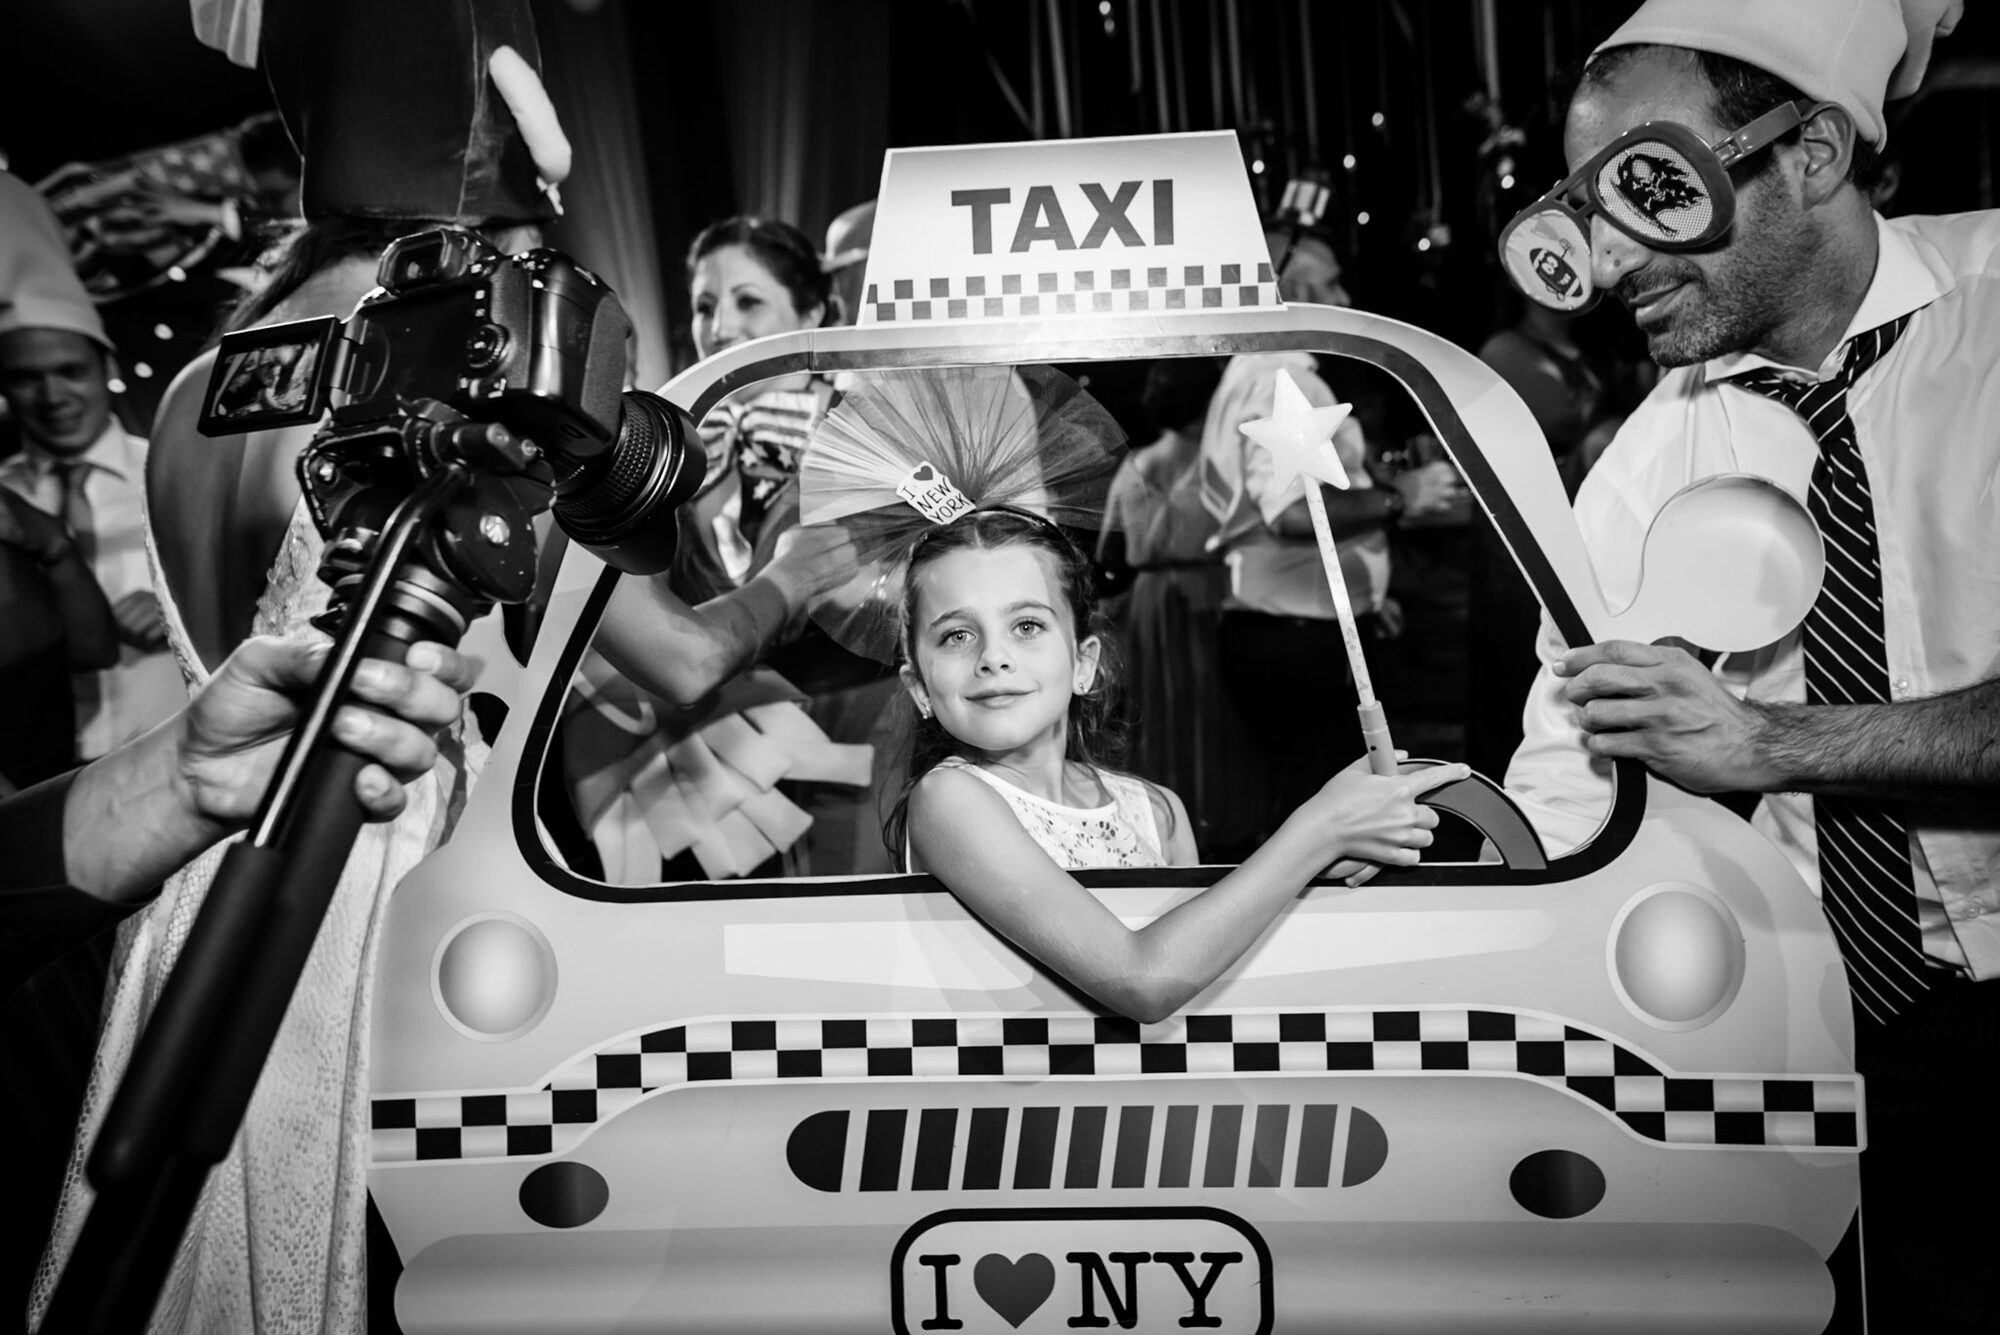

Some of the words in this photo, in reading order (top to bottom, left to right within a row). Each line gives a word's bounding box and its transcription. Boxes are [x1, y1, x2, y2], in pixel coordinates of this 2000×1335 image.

[951, 179, 1174, 255] TAXI
[901, 485, 916, 501] I
[916, 476, 952, 513] NEW
[928, 492, 971, 523] YORK
[918, 1253, 964, 1331] I
[1065, 1251, 1244, 1331] NY
